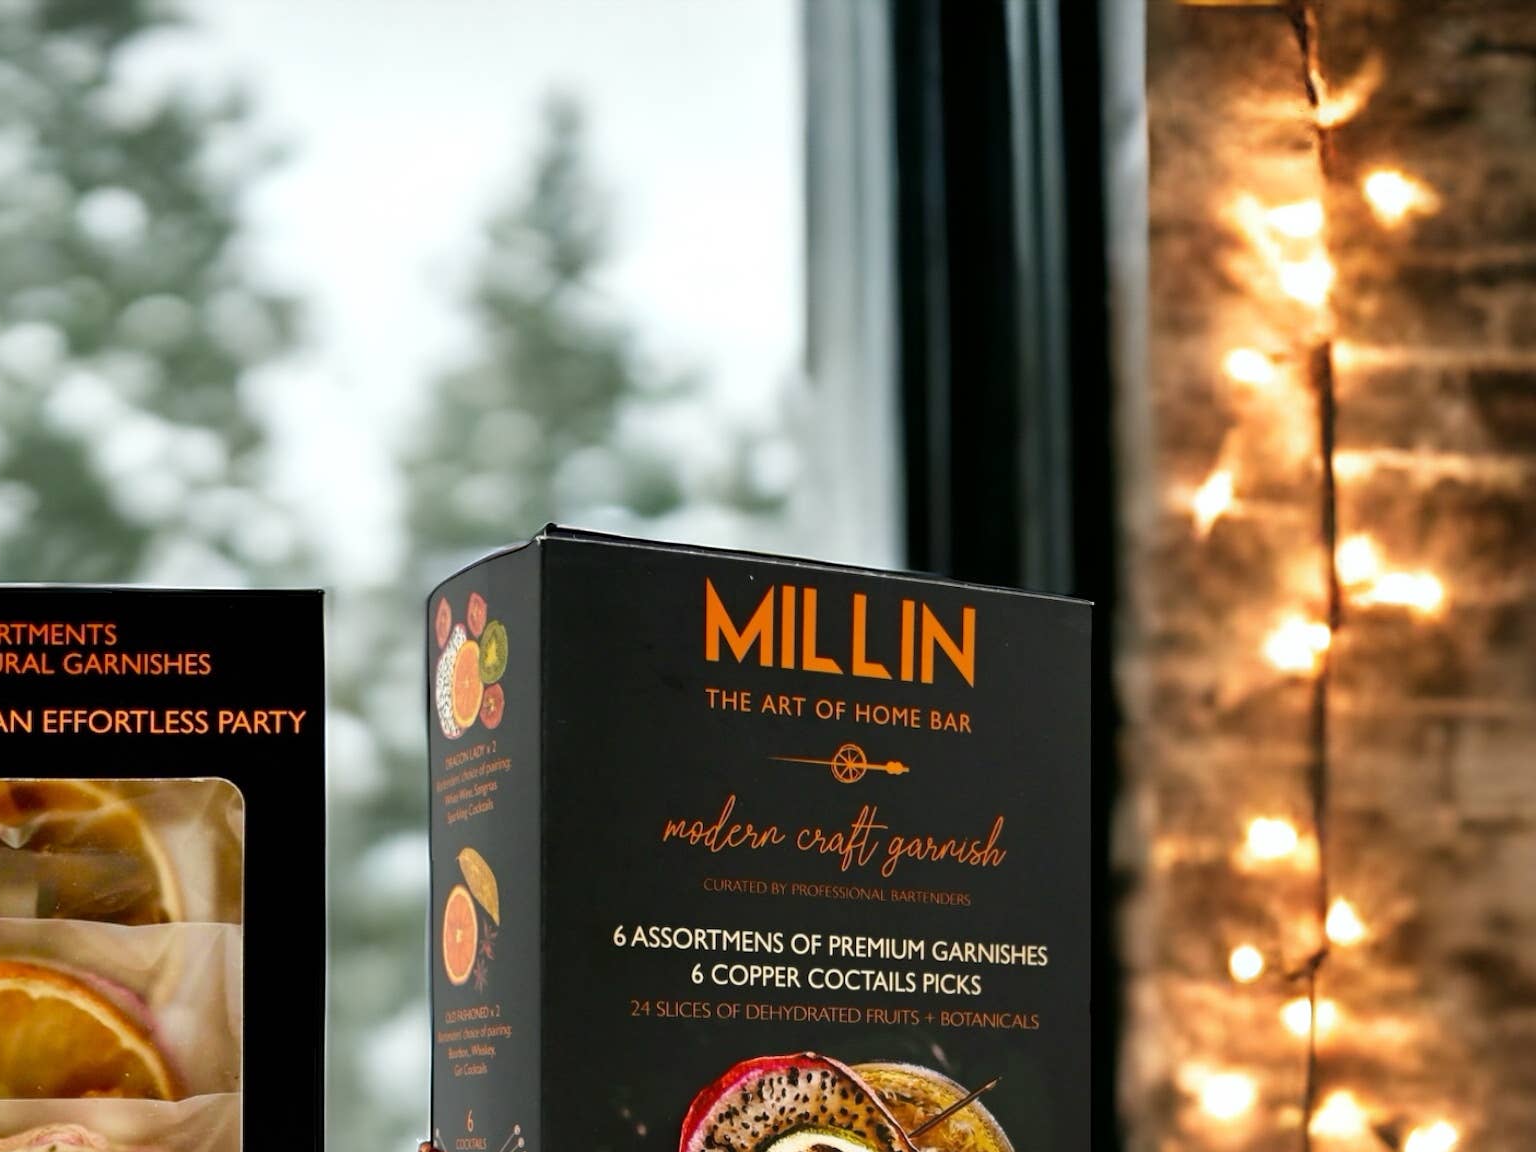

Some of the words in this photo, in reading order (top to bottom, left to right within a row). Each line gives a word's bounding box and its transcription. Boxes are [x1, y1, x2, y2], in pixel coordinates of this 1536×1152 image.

[706, 576, 976, 687] MILLIN
[63, 652, 211, 675] GARNISHES
[43, 709, 209, 734] EFFORTLESS
[219, 710, 306, 734] PARTY
[705, 688, 751, 712] THE
[762, 694, 806, 716] ART
[816, 699, 846, 720] OF
[856, 703, 920, 728] HOME
[930, 710, 971, 733] BAR
[663, 794, 786, 852] modern
[797, 805, 888, 872] craft
[881, 816, 1007, 878] garnish
[704, 878, 768, 893] CURATED
[771, 882, 786, 895] BY
[791, 883, 886, 901] PROFESSIONAL
[891, 889, 971, 906] BARTENDERS
[613, 925, 626, 946] 6
[631, 926, 784, 953] ASSORTMENS
[791, 933, 821, 955] OF
[829, 935, 924, 960] PREMIUM
[932, 941, 1048, 966] GARNISHES
[691, 963, 704, 984] 6
[711, 964, 801, 988] COPPER
[808, 968, 916, 993] COCTAILS
[923, 973, 981, 995] PICKS
[631, 1000, 650, 1016] 24
[656, 1001, 711, 1018] SLICES
[717, 1003, 740, 1019] OF
[746, 1004, 861, 1023] DEHYDRATED
[866, 1008, 920, 1025] FRUITS
[925, 1012, 934, 1023] +
[941, 1011, 1039, 1029] BOTANICALS
[467, 1110, 474, 1132] 6
